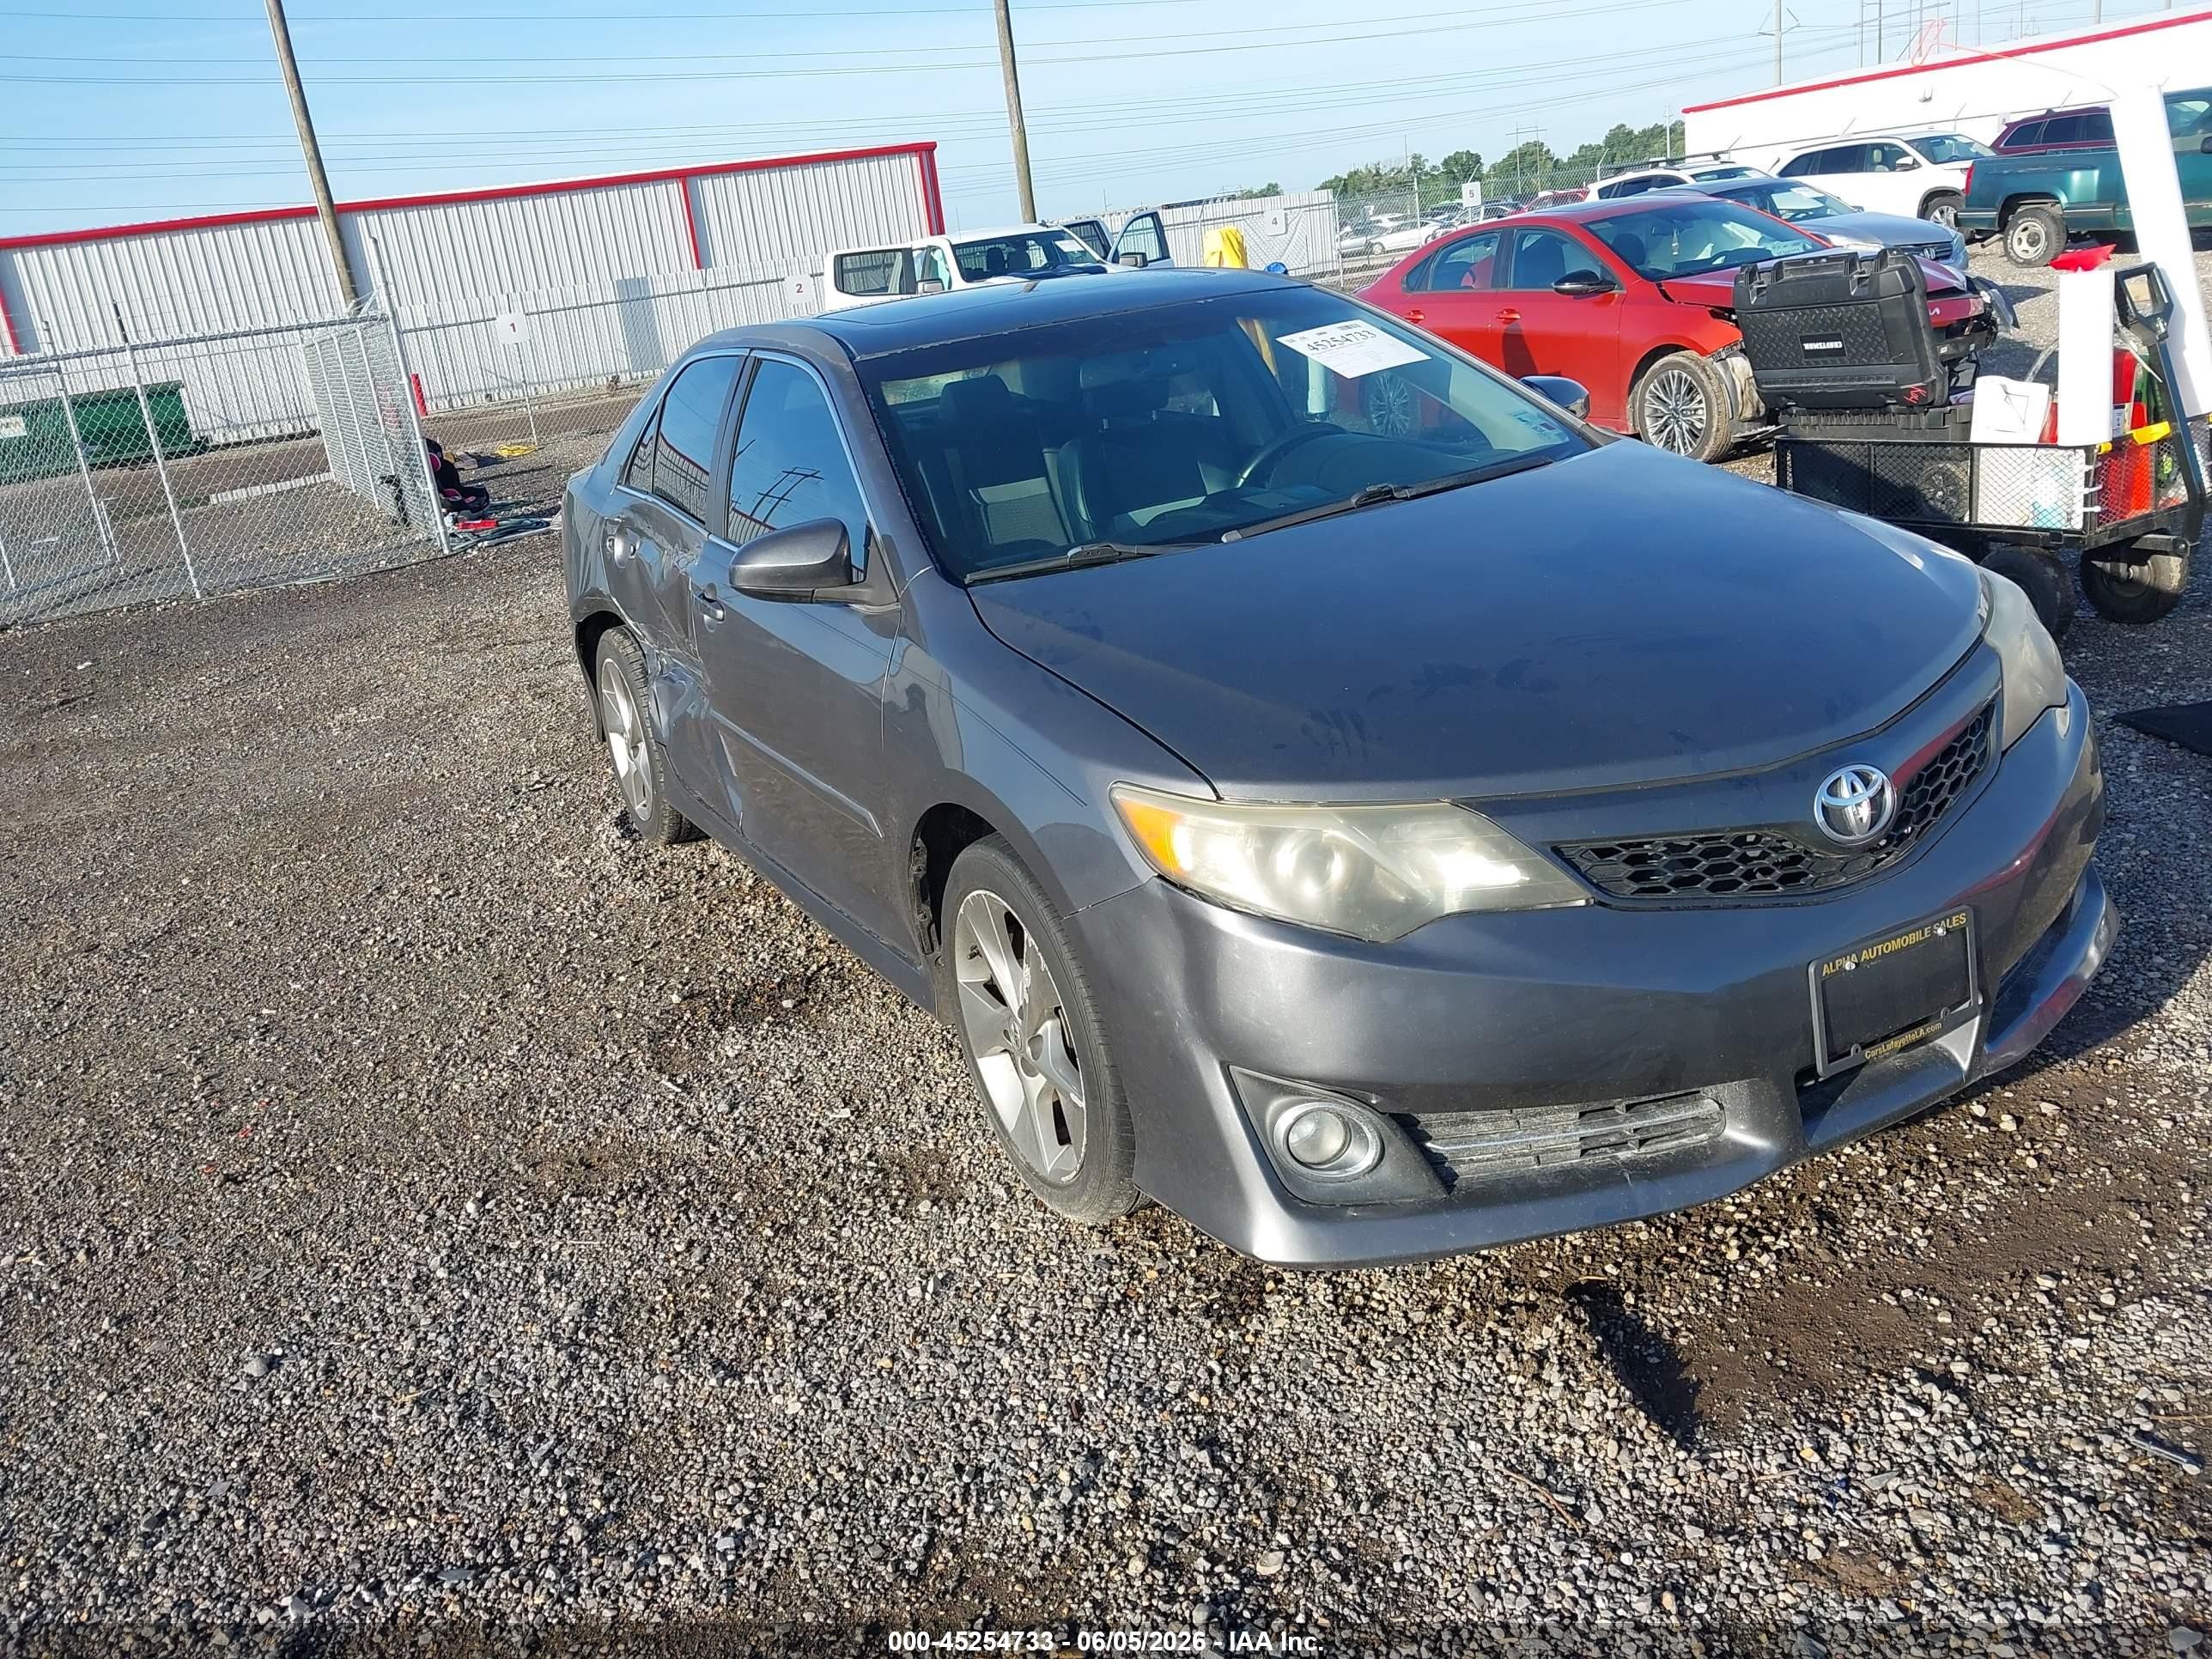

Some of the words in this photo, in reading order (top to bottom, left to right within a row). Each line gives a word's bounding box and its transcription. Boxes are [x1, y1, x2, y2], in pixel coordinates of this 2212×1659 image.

[1468, 189, 1474, 198] 5
[1272, 216, 1279, 226] 4
[795, 283, 804, 294] 2
[509, 322, 516, 332] 1
[1306, 330, 1378, 351] 45254733
[1821, 953, 1859, 976] ALPHA
[1861, 926, 1931, 963] AUTOMOBILE
[1932, 912, 1967, 936] SALES
